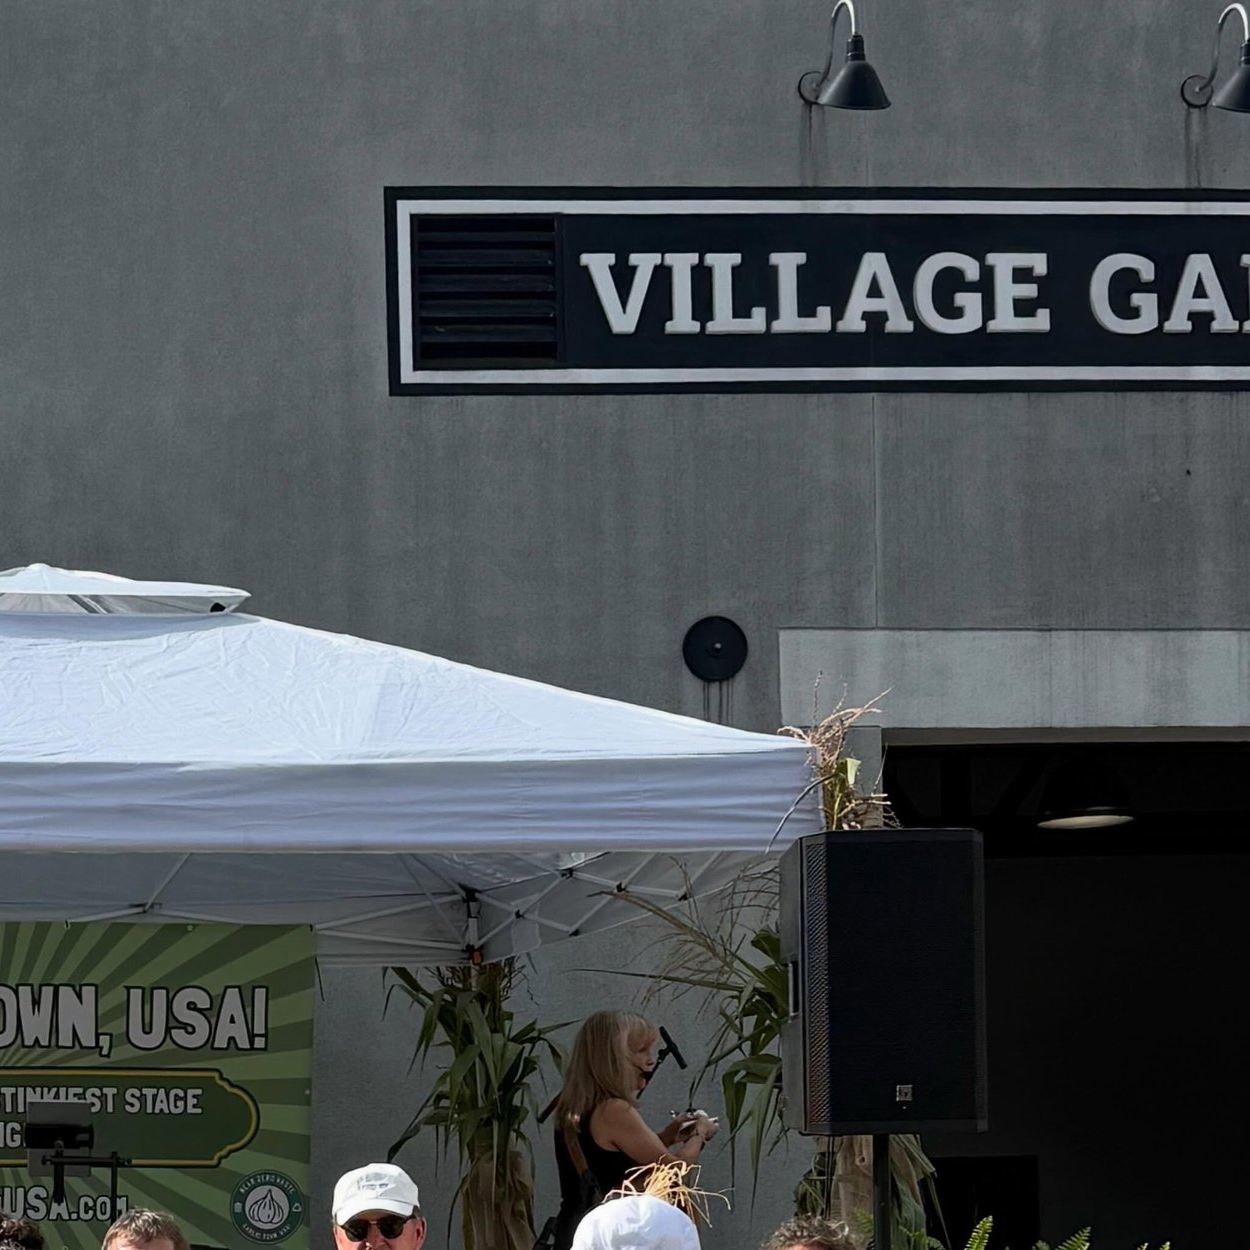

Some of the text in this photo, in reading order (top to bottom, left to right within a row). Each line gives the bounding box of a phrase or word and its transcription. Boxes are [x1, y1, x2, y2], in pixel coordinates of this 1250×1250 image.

[579, 252, 1250, 335] VILLAGE GA
[126, 986, 268, 1051] USA!
[124, 1088, 203, 1115] STAGE
